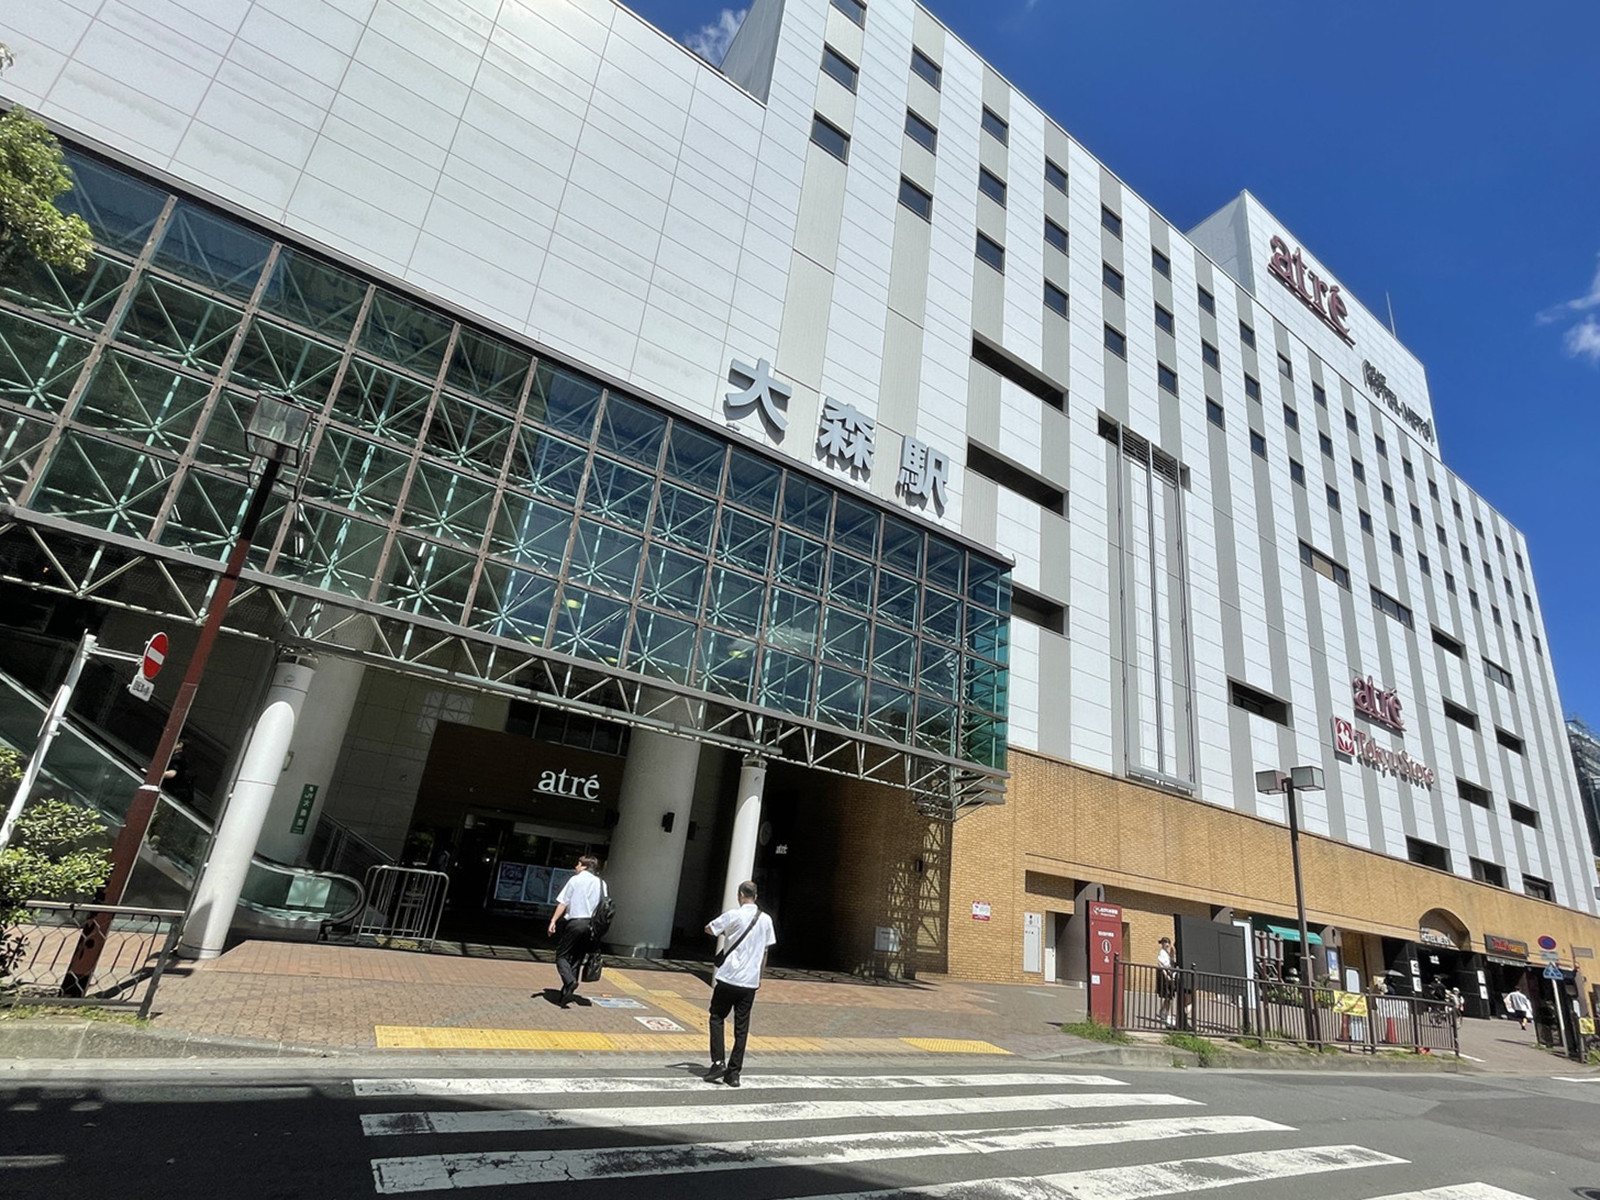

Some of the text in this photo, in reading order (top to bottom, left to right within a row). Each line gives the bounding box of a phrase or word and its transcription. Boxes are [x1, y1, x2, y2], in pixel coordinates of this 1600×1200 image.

[1269, 234, 1350, 337] atré
[725, 357, 950, 510] 大森駅
[1352, 675, 1405, 729] atré
[537, 768, 600, 800] atré
